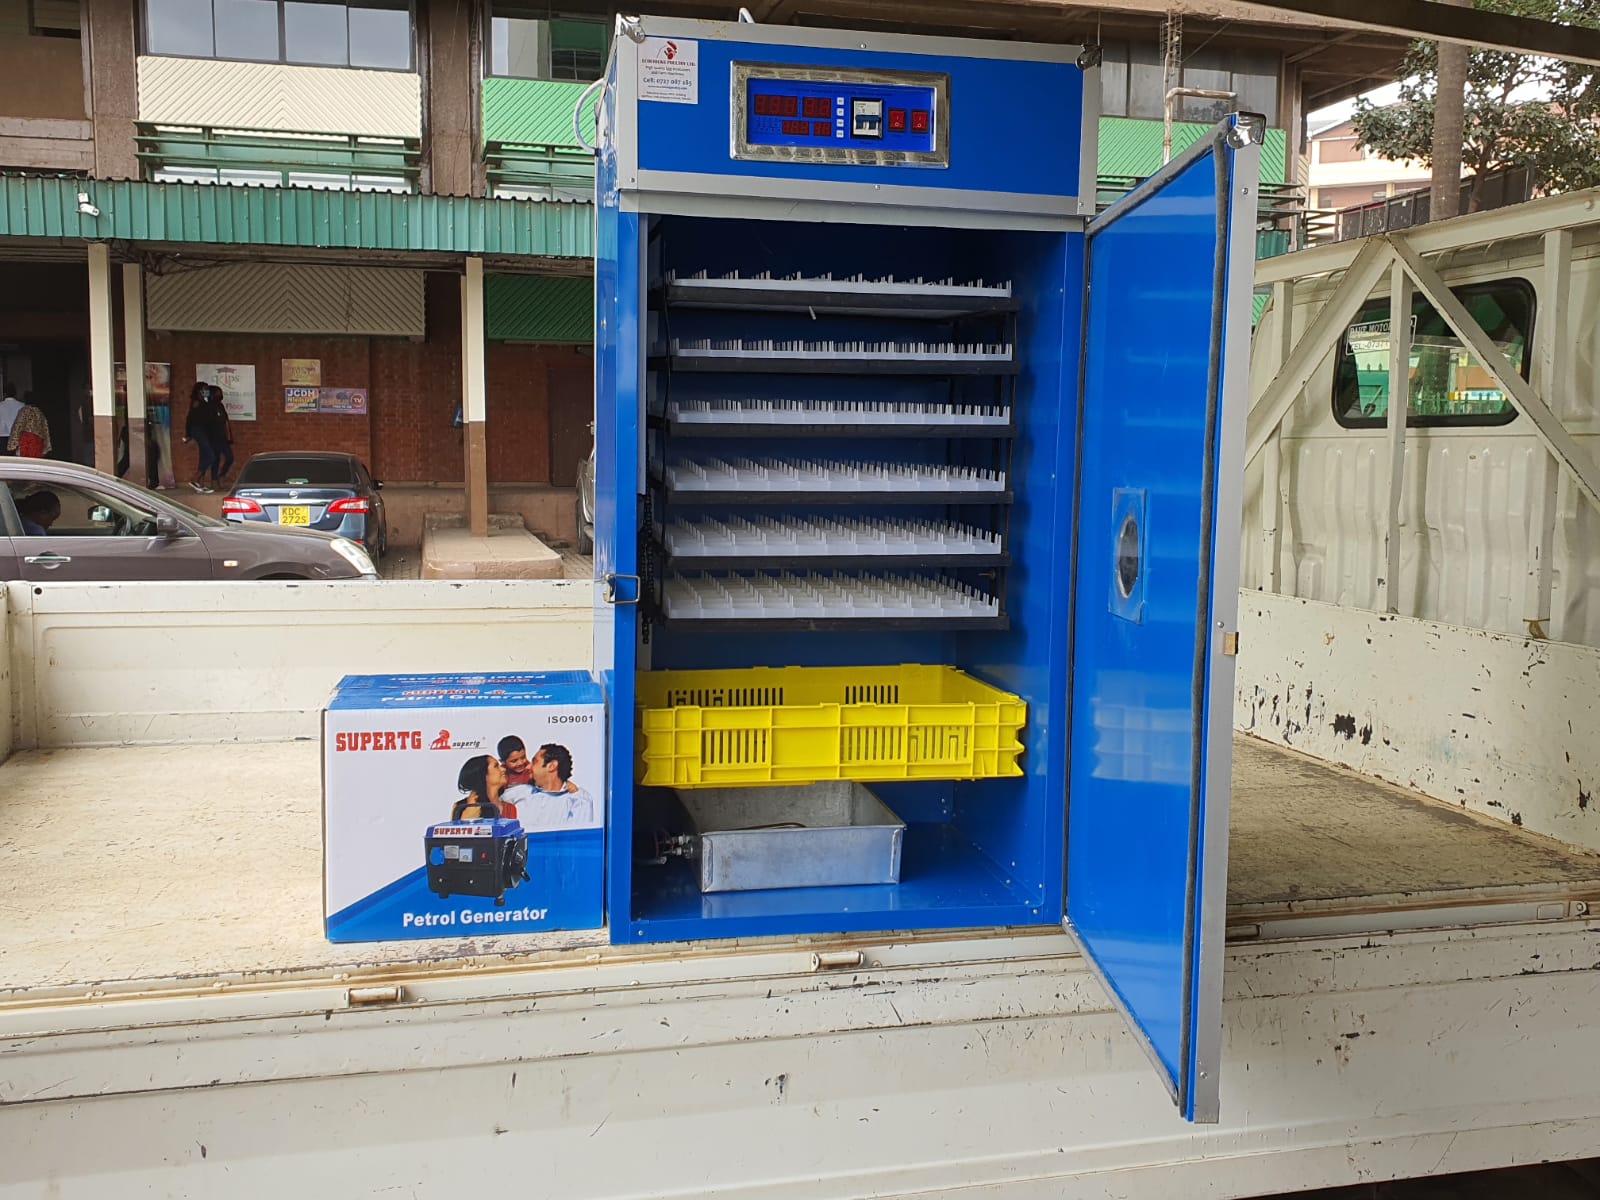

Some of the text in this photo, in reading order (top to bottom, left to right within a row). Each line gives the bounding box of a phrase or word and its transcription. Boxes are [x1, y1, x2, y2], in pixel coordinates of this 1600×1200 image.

[282, 507, 300, 516] KDC
[547, 715, 594, 724] ISO9001
[335, 731, 481, 752] SUPERTG supertg
[402, 907, 548, 927] Petrol Generator
